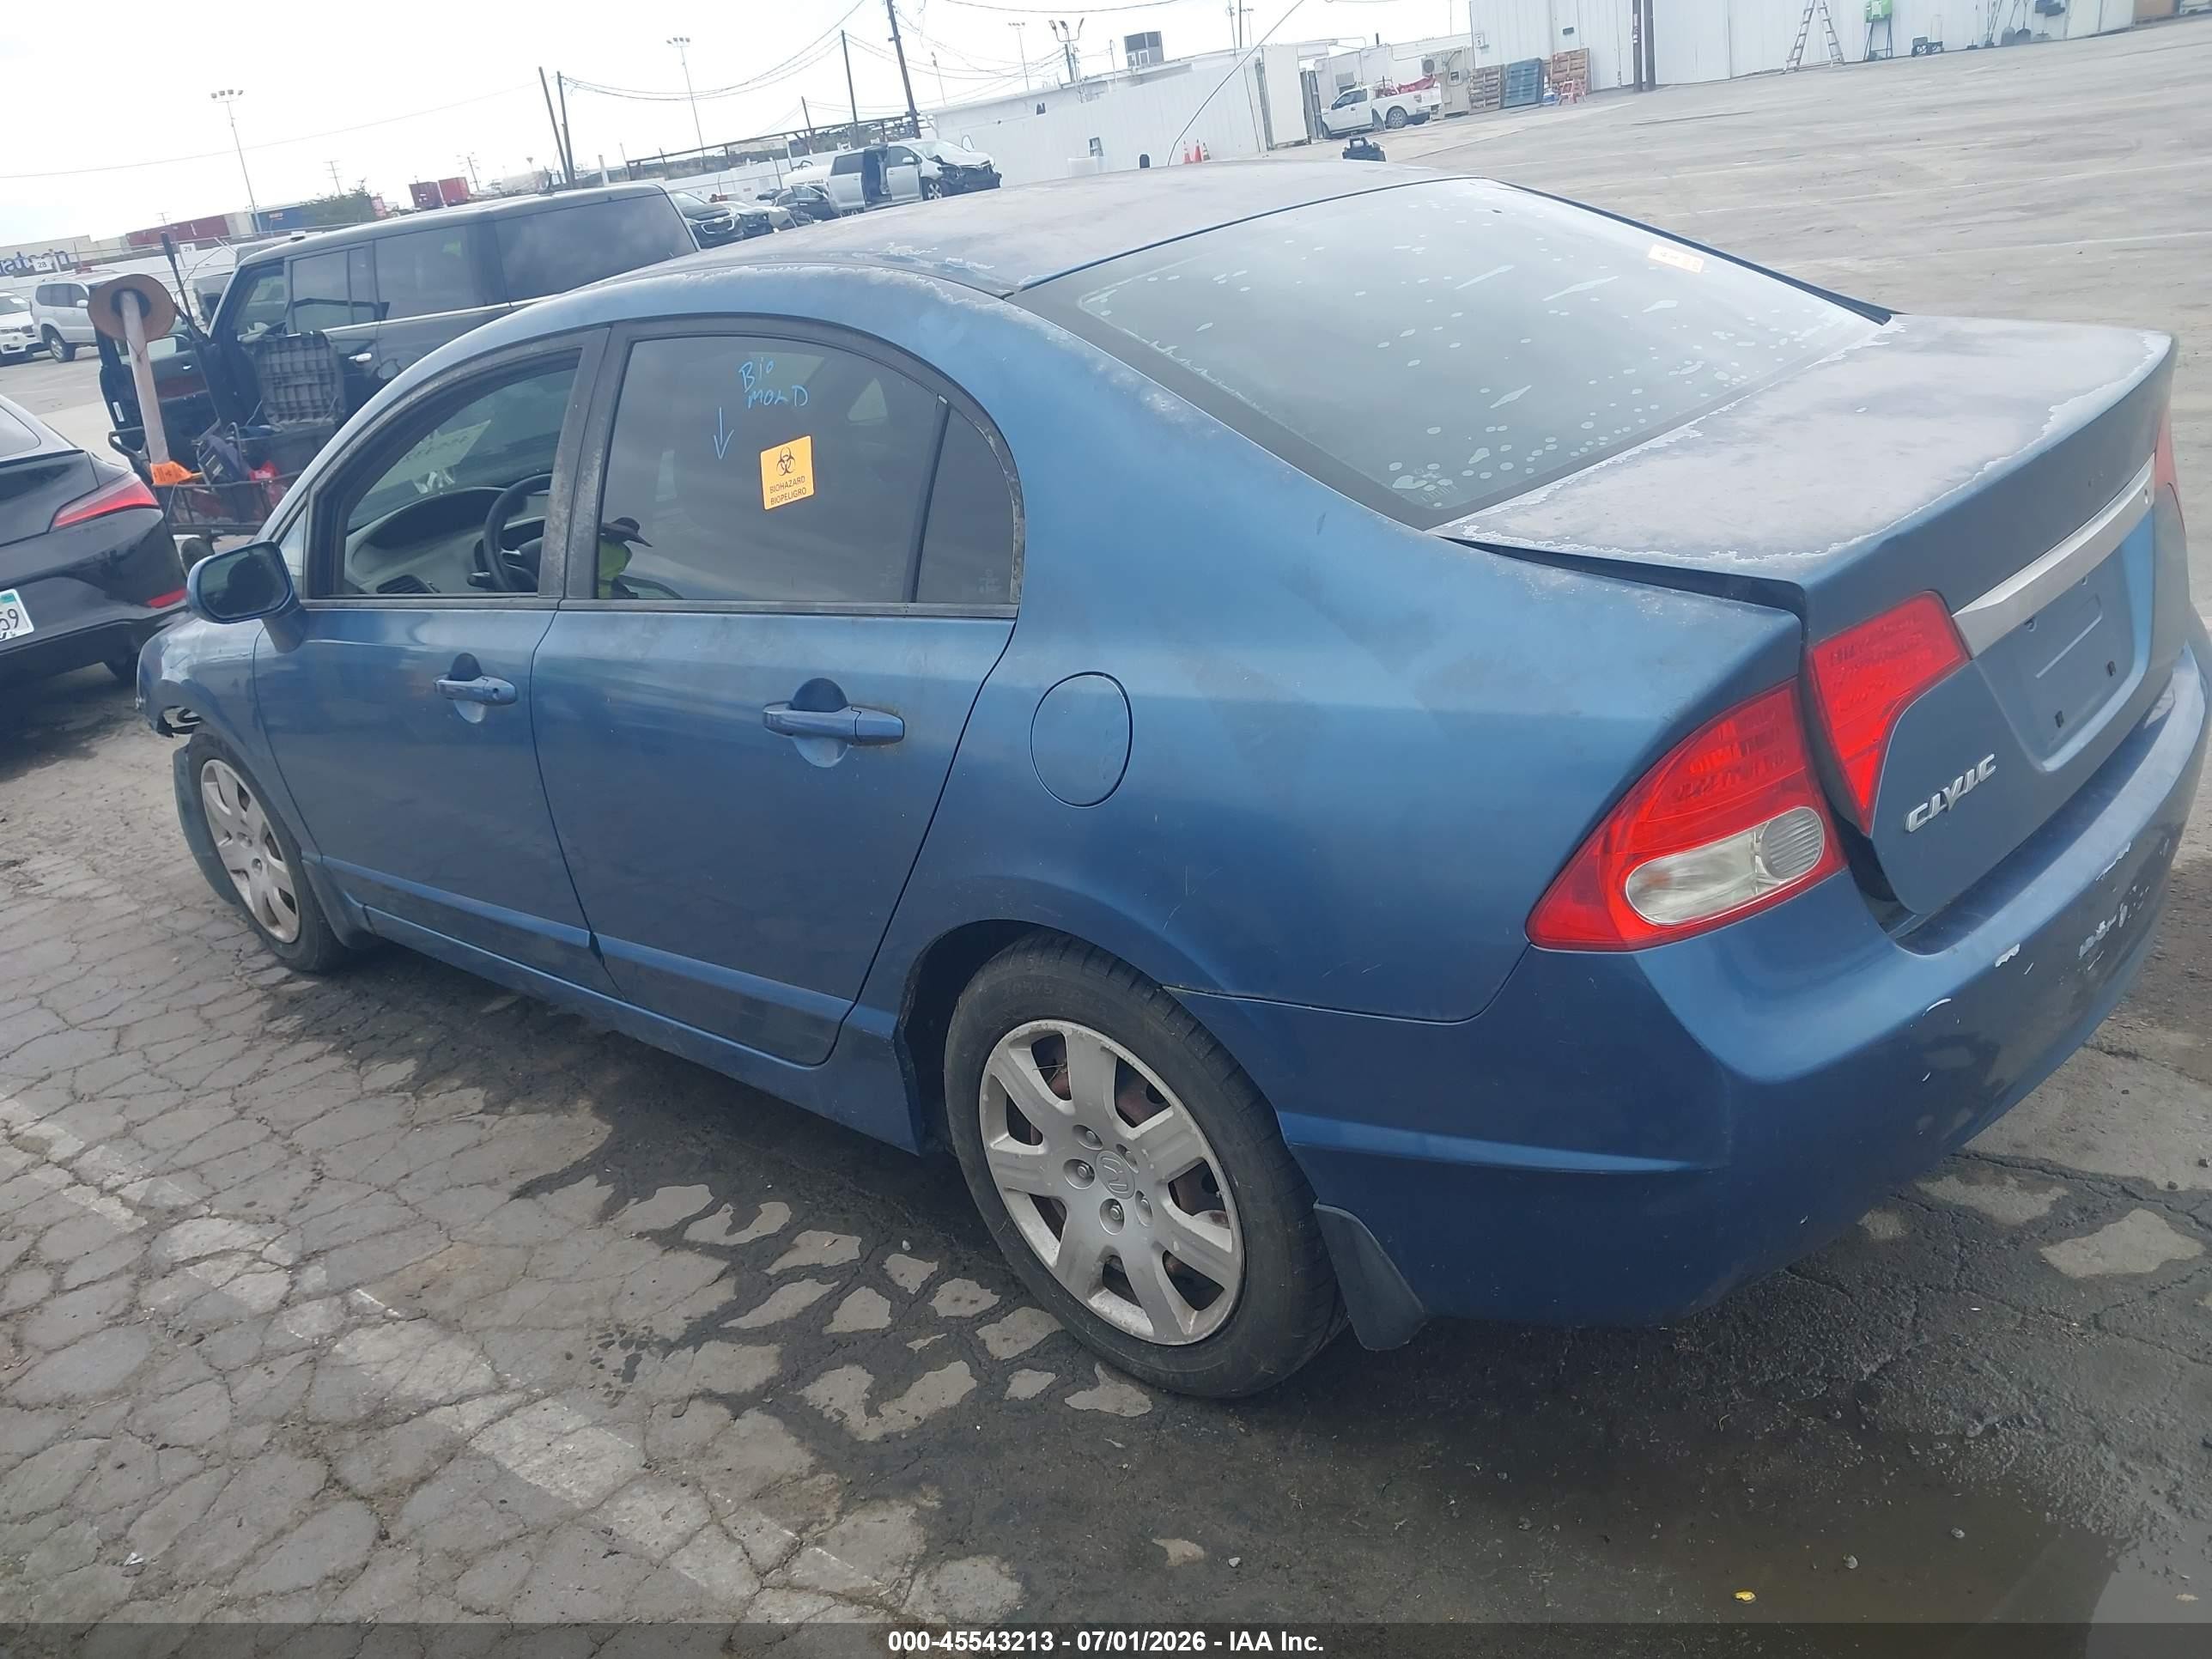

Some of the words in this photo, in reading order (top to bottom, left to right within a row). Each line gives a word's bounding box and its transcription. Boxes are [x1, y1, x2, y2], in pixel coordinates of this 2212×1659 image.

[769, 475, 805, 494] BIOHAZARD
[770, 487, 807, 505] BIOPELIGRO
[1905, 753, 1996, 833] CIVIC
